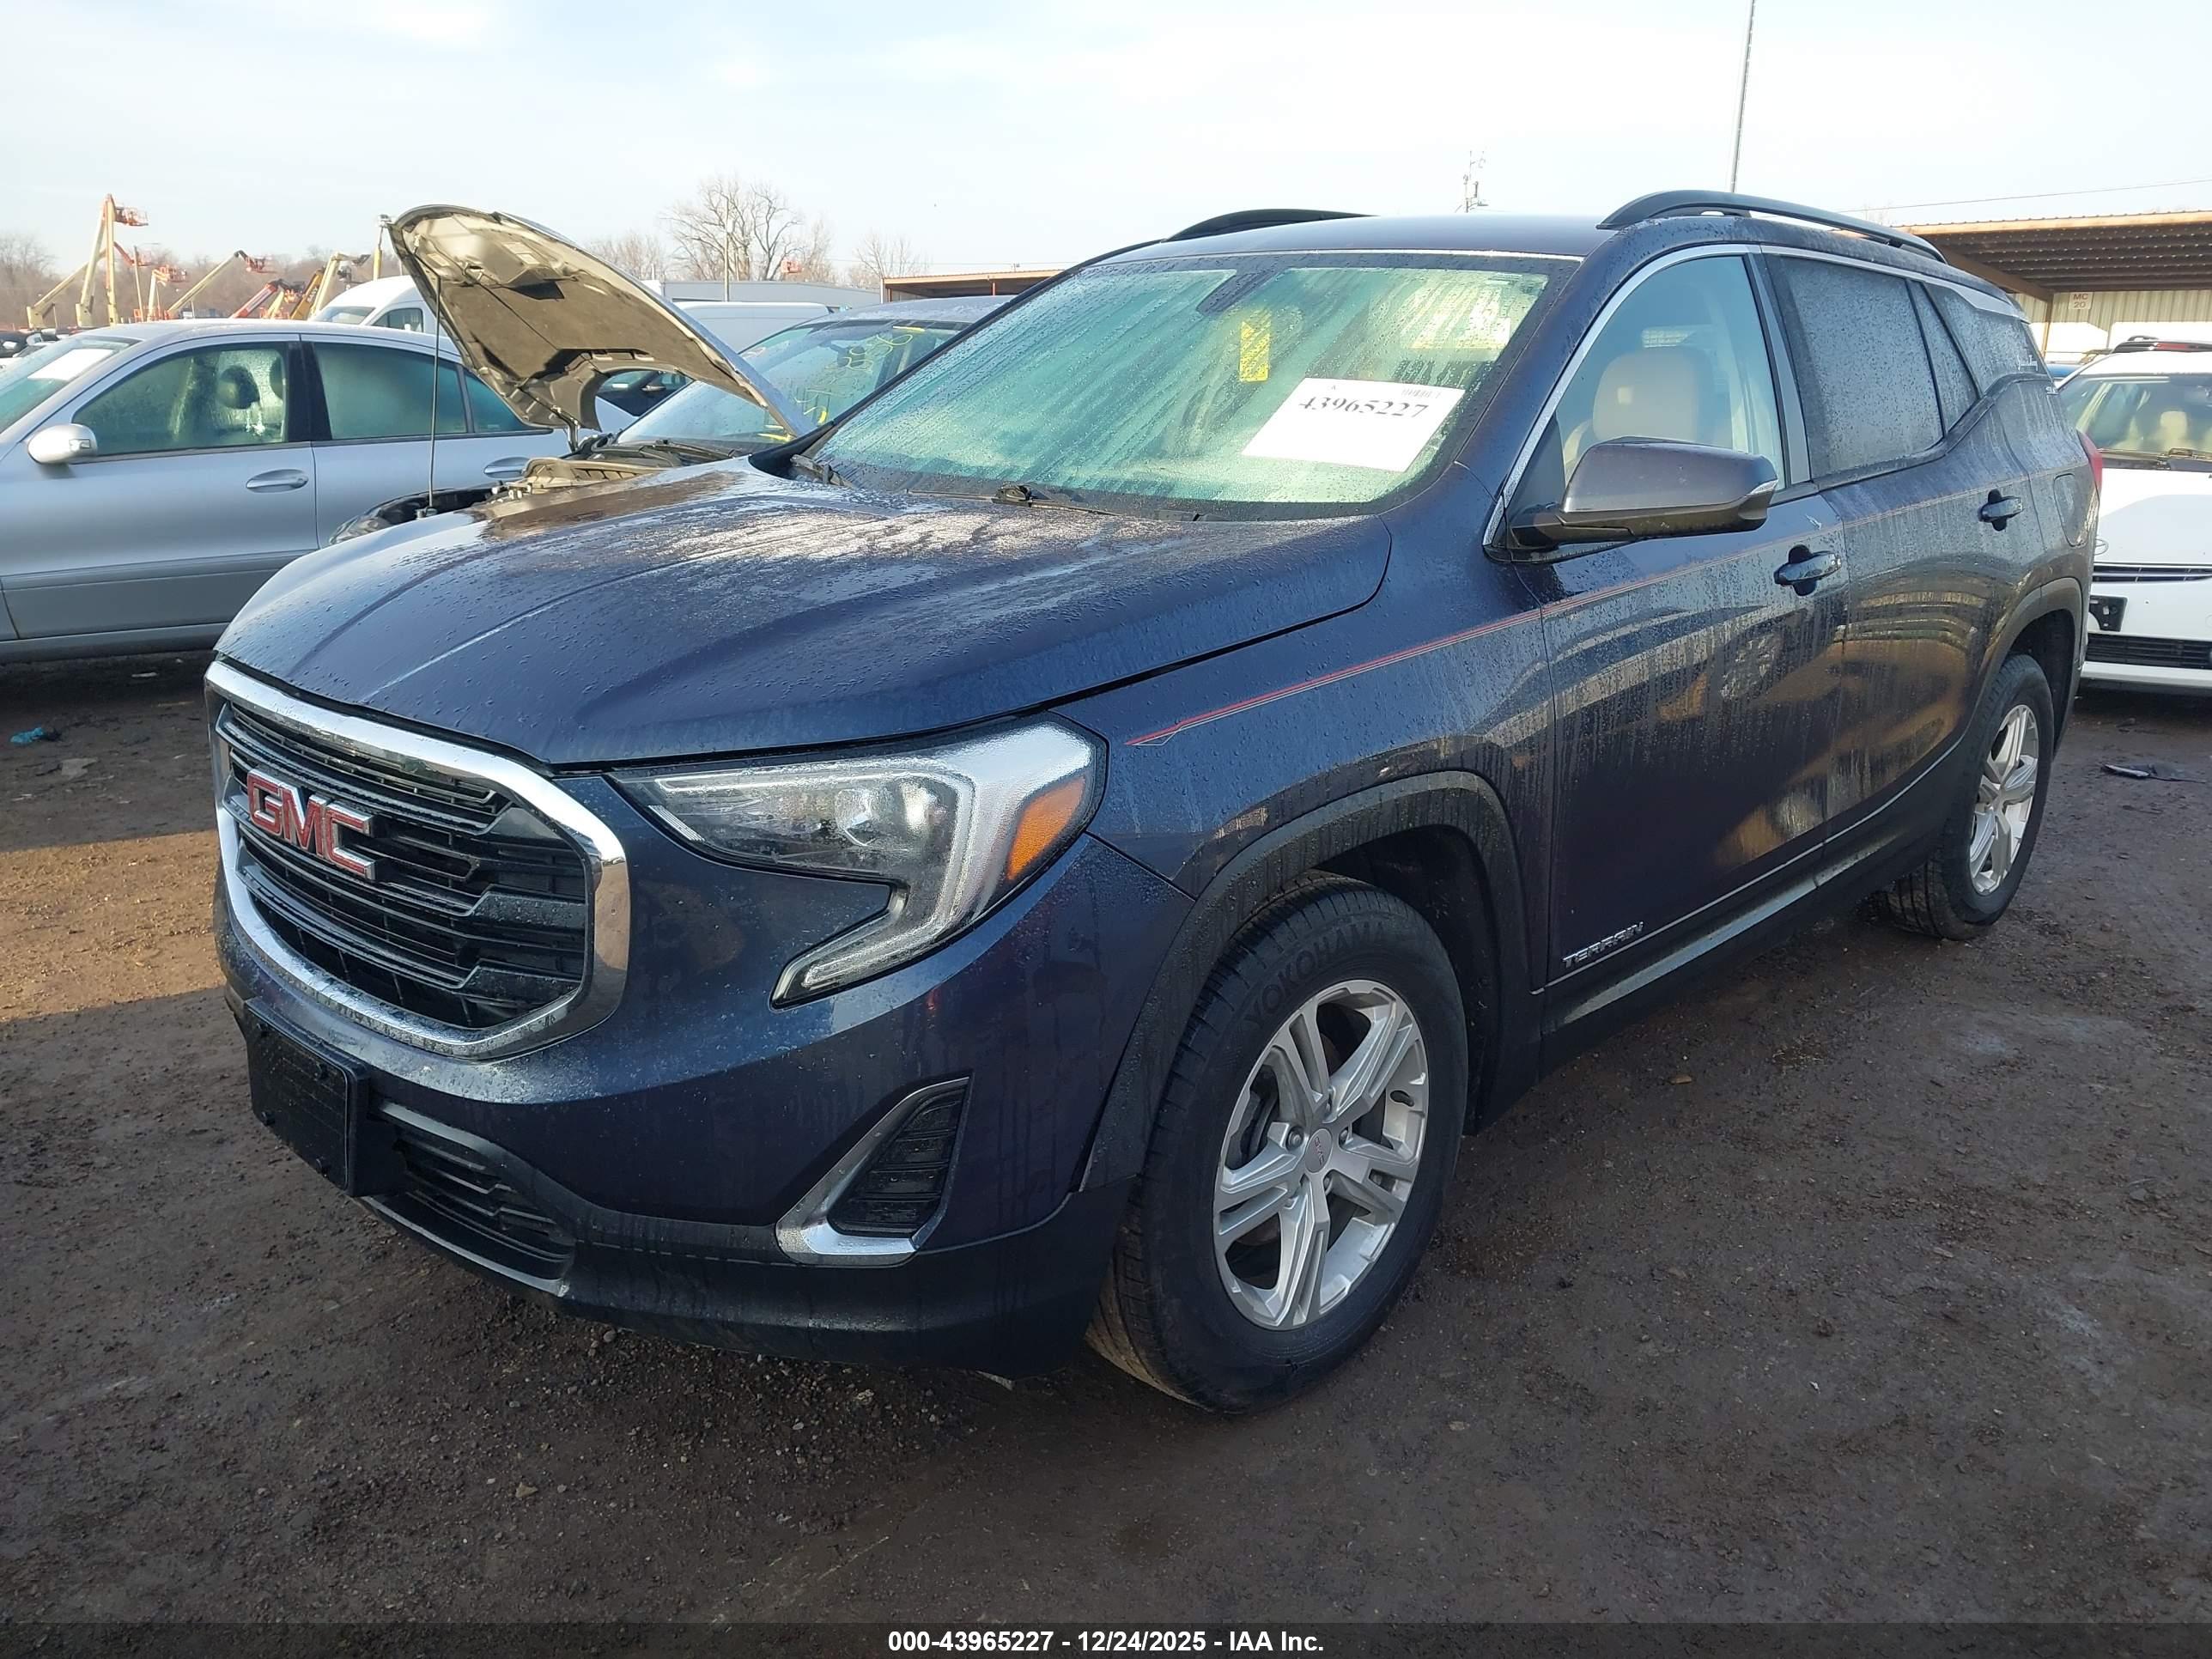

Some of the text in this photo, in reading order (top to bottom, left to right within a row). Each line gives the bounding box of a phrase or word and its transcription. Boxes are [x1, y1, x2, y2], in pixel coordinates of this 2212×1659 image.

[1298, 396, 1430, 418] 43965227
[246, 769, 377, 883] GMC
[1243, 921, 1387, 1030] YOKOHAMA
[1563, 921, 1644, 968] TERRAIN
